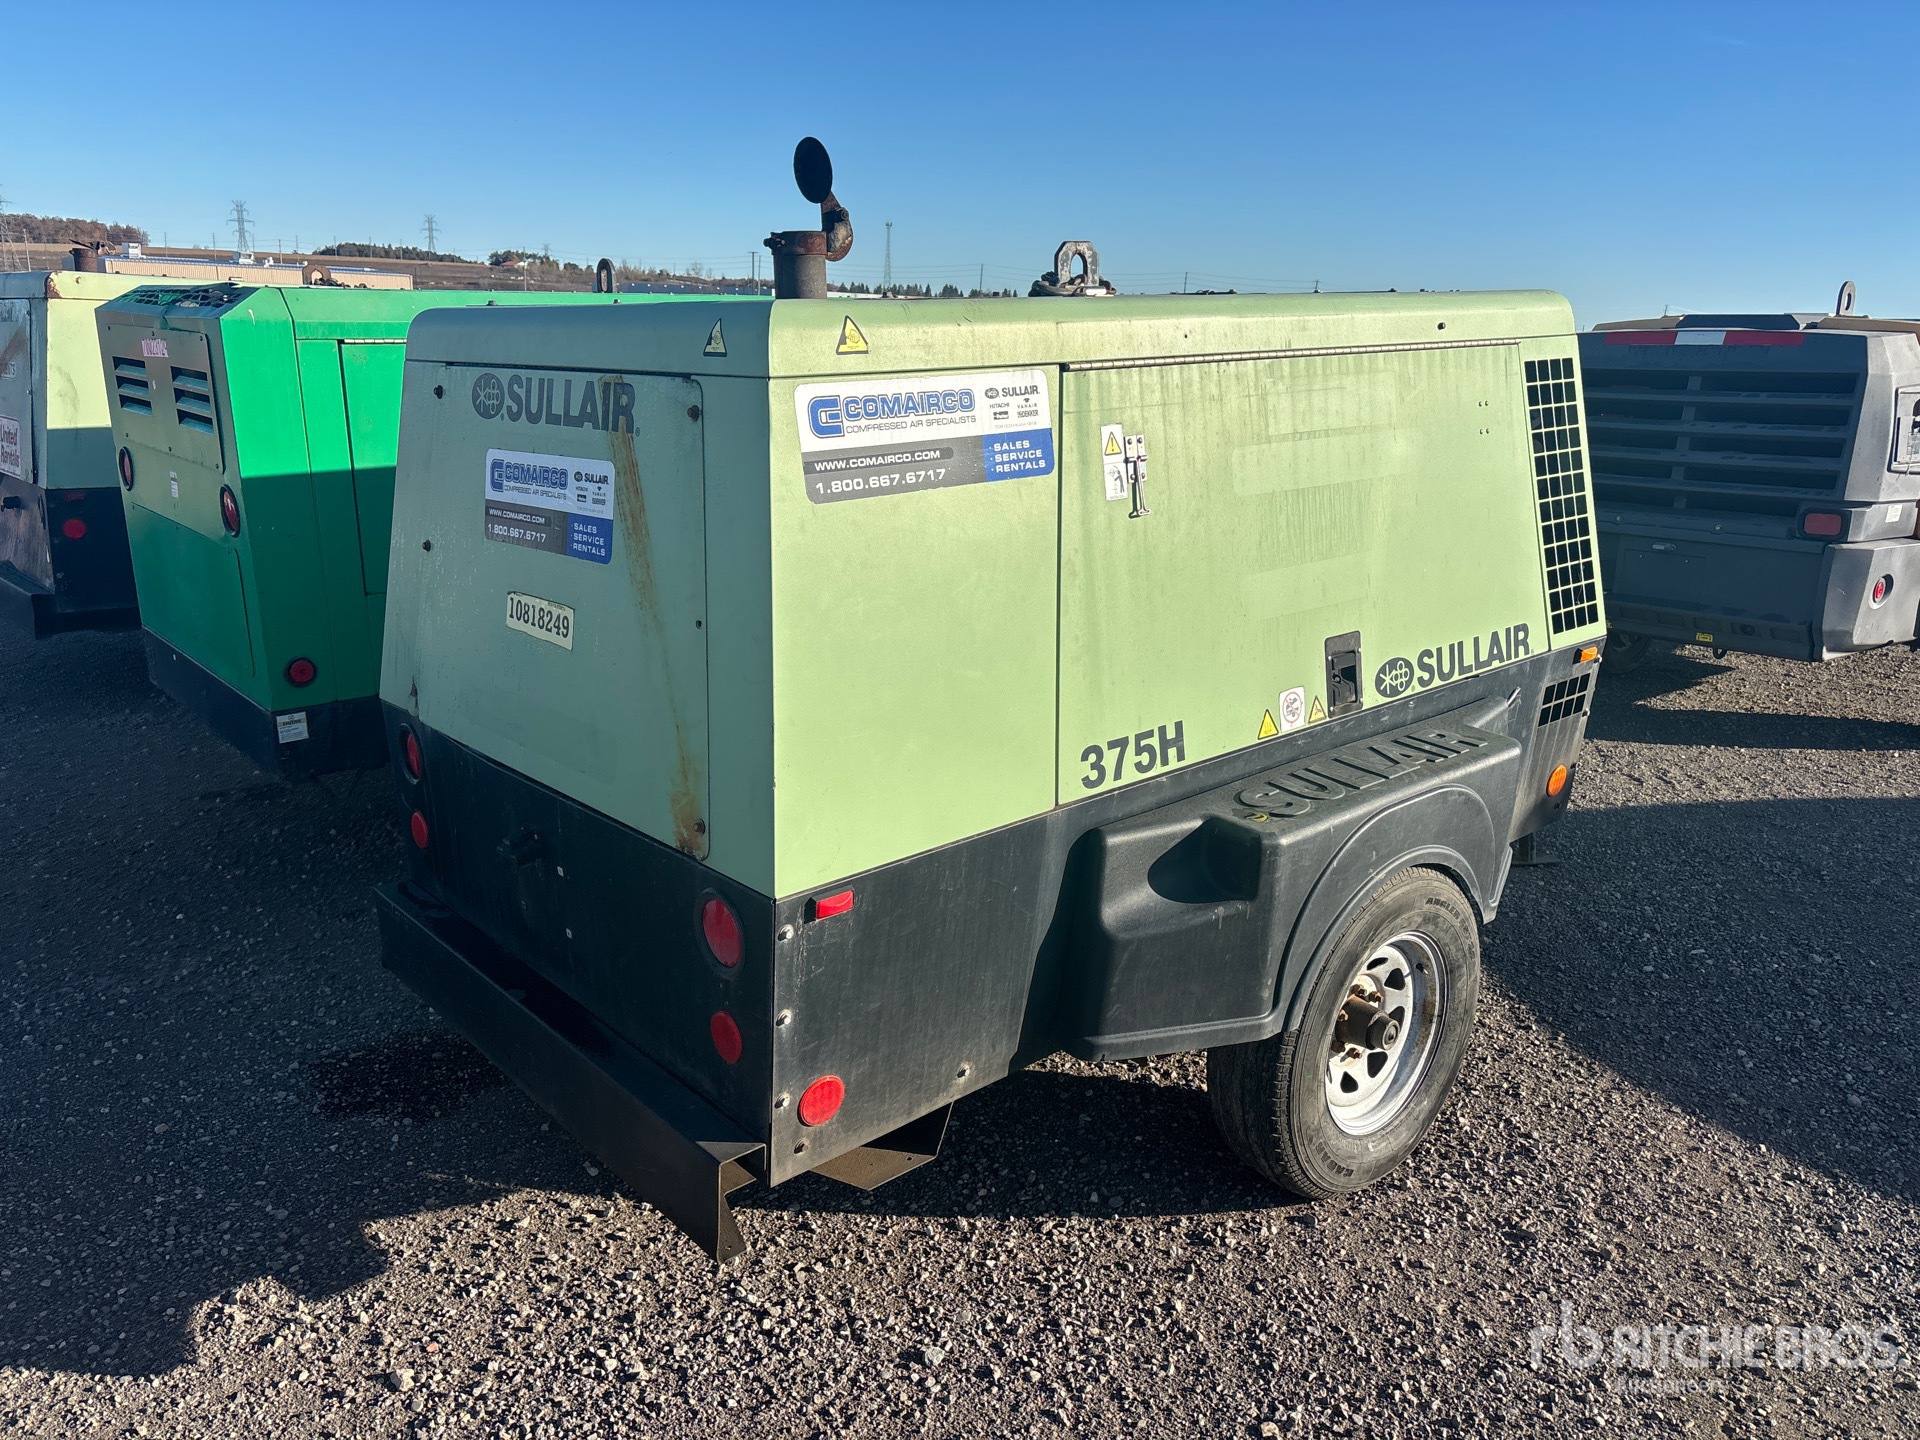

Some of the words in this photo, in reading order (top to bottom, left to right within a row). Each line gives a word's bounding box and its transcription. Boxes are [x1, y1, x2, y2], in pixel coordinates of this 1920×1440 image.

[1002, 385, 1039, 397] SULLAIR
[506, 374, 636, 434] SULLAIR
[842, 389, 976, 421] COMAIRCO
[846, 421, 908, 434] COMPRESSED
[910, 419, 924, 428] AIR
[925, 415, 977, 427] SPECIALISTS
[994, 440, 1030, 451] SALES
[814, 450, 941, 471] WWW.COMAIRCO.COM
[995, 449, 1043, 462] SERVICE
[504, 461, 569, 490] COMAIRCO
[996, 460, 1046, 473] RENTALS
[584, 473, 609, 485] SULLAIR
[815, 468, 946, 494] 1.800.667.6717
[489, 508, 545, 524] WWW.COMAIRCO.COM
[488, 523, 546, 543] 1.800.667.6717
[574, 522, 597, 534] SALES
[573, 533, 604, 545] SERVICE
[573, 543, 606, 556] RENTALS
[509, 597, 569, 639] 10818249
[1417, 622, 1530, 688] SULLAIR
[1080, 720, 1186, 789] 375H
[1233, 728, 1488, 818] SULLAIR
